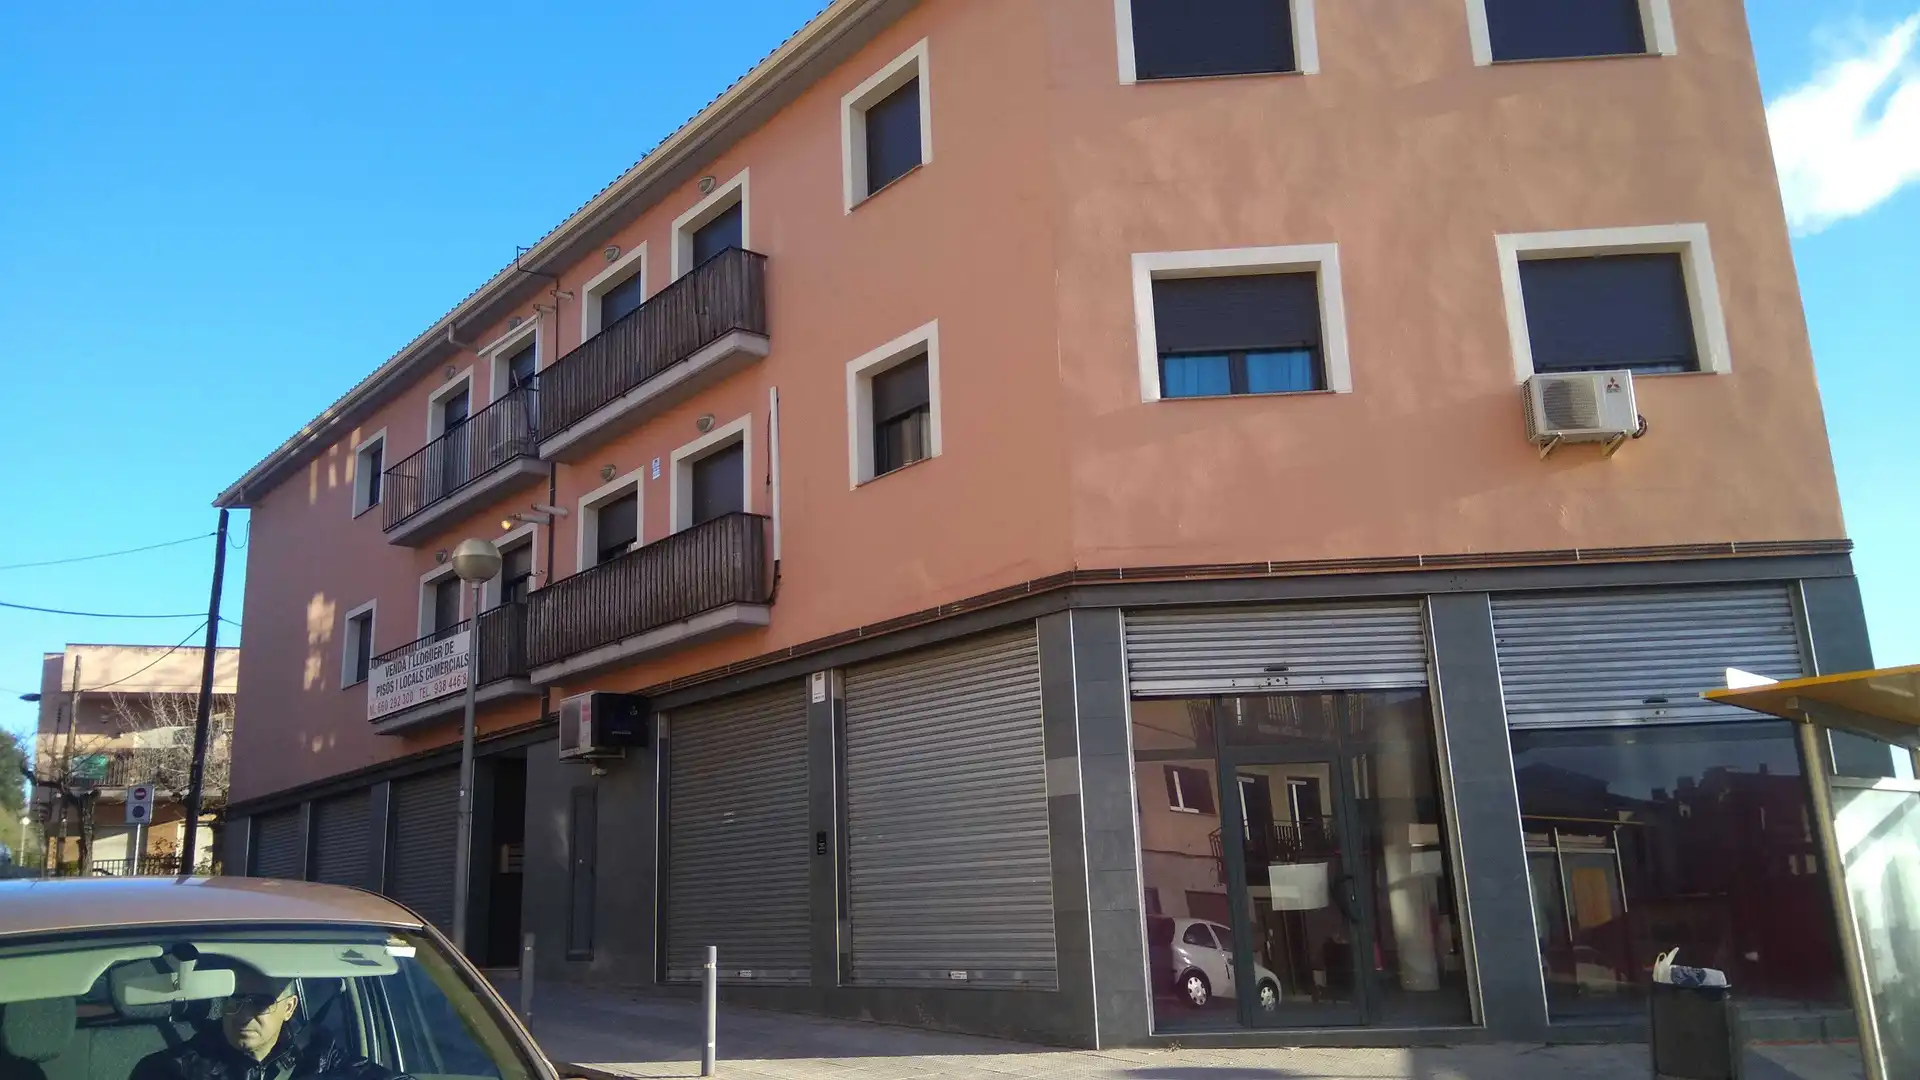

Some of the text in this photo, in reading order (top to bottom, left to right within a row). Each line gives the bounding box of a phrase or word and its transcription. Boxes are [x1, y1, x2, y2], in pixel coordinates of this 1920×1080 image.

[376, 653, 469, 698] PISOS I LOCALS COMERCIALS
[384, 640, 454, 678] VENDA I LLOGUER DE
[389, 696, 401, 709] 292
[402, 691, 414, 705] 300
[433, 680, 446, 694] 938
[448, 676, 461, 688] 446
